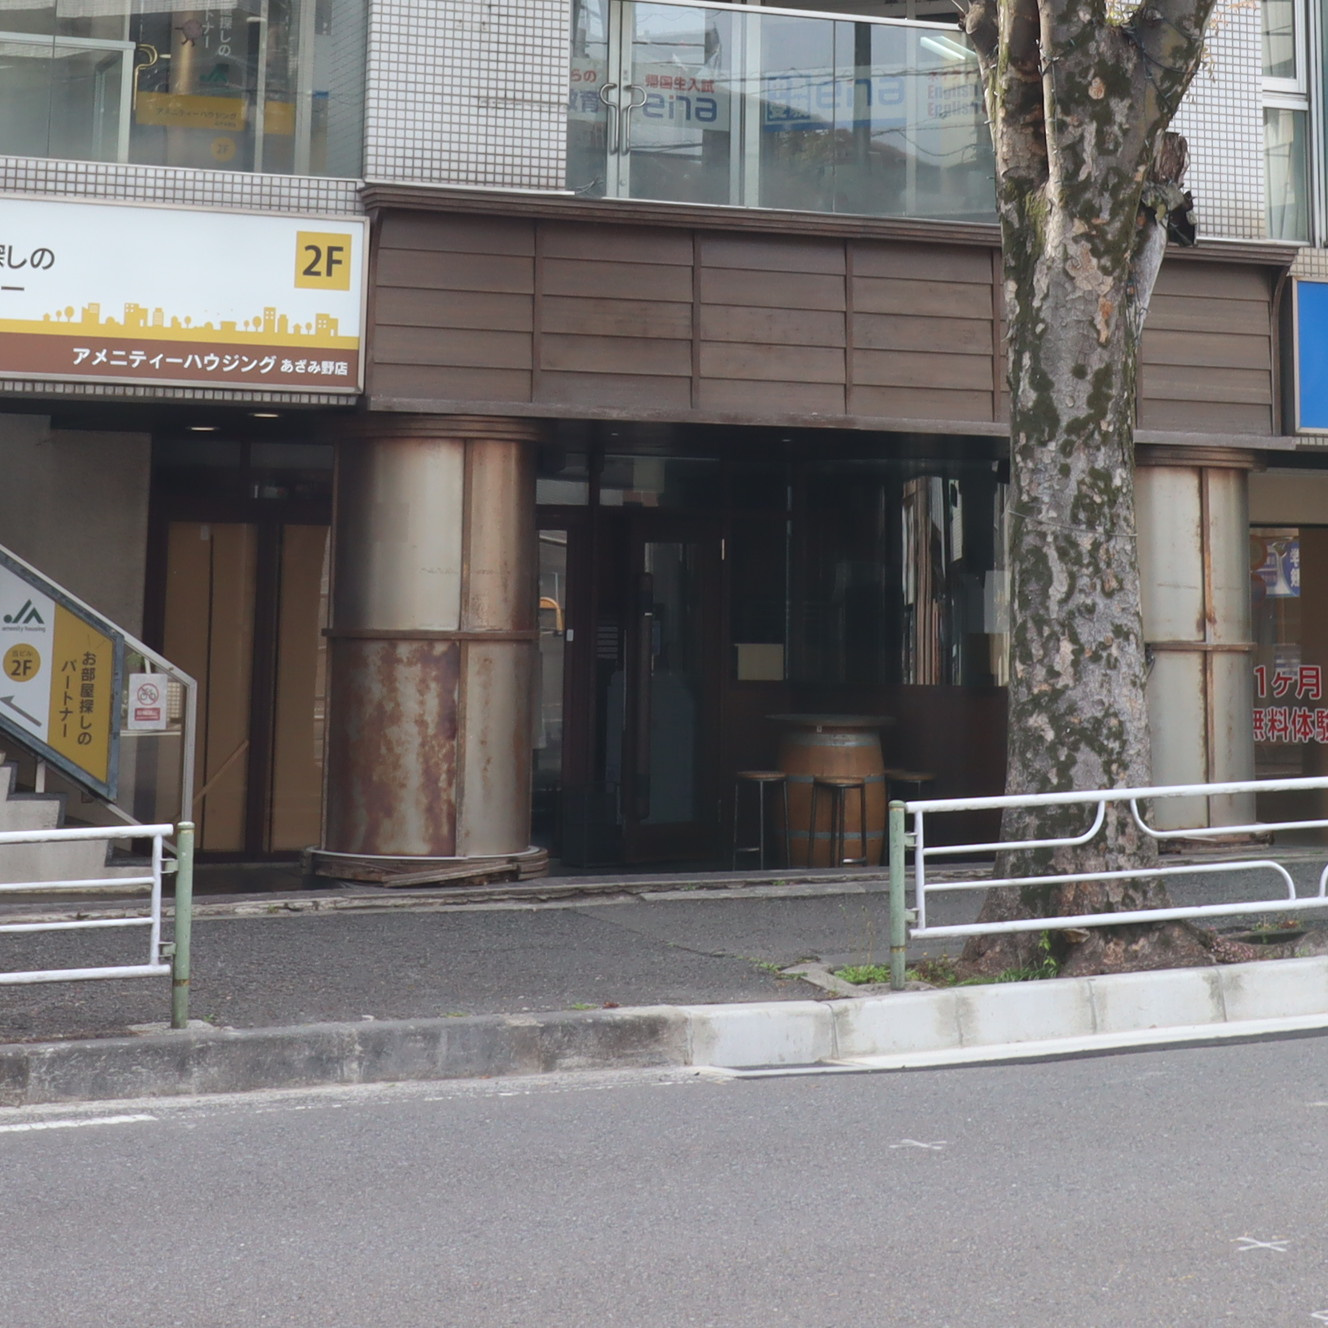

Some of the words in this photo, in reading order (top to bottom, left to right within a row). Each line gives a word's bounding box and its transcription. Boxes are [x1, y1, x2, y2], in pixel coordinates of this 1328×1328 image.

[645, 73, 715, 93] 帰国生入試
[642, 93, 718, 122] ena
[303, 243, 345, 278] 2F
[73, 347, 277, 374] アメニティーハウジング
[280, 357, 349, 377] あざみ野店
[11, 660, 32, 676] 2F
[59, 660, 77, 738] パートナー
[77, 651, 96, 746] お部屋探しの
